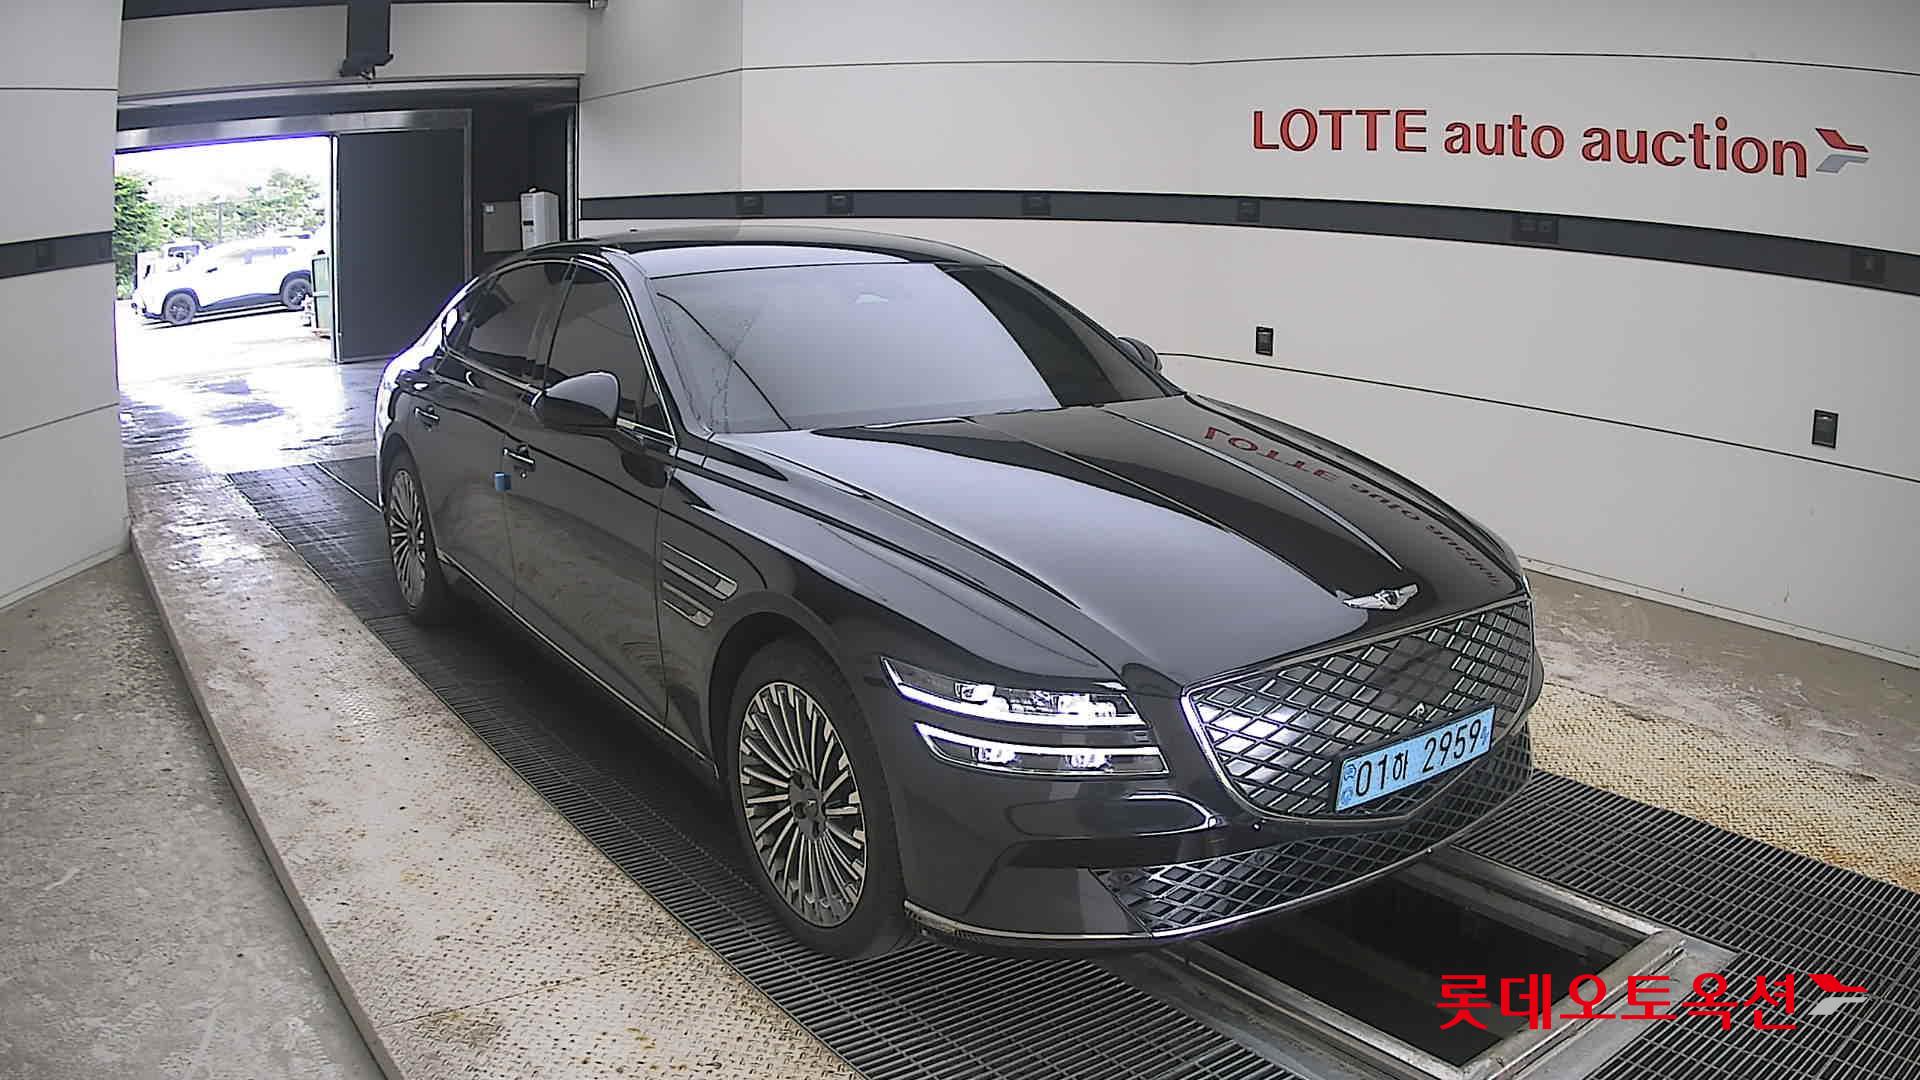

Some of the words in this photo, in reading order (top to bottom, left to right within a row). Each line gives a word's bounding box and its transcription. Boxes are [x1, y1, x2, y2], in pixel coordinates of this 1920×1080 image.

[1253, 109, 1427, 152] LOTTE
[1444, 115, 1566, 159] auto
[1582, 117, 1809, 179] auction
[1355, 749, 1409, 797] 01하
[1422, 718, 1482, 773] 2959
